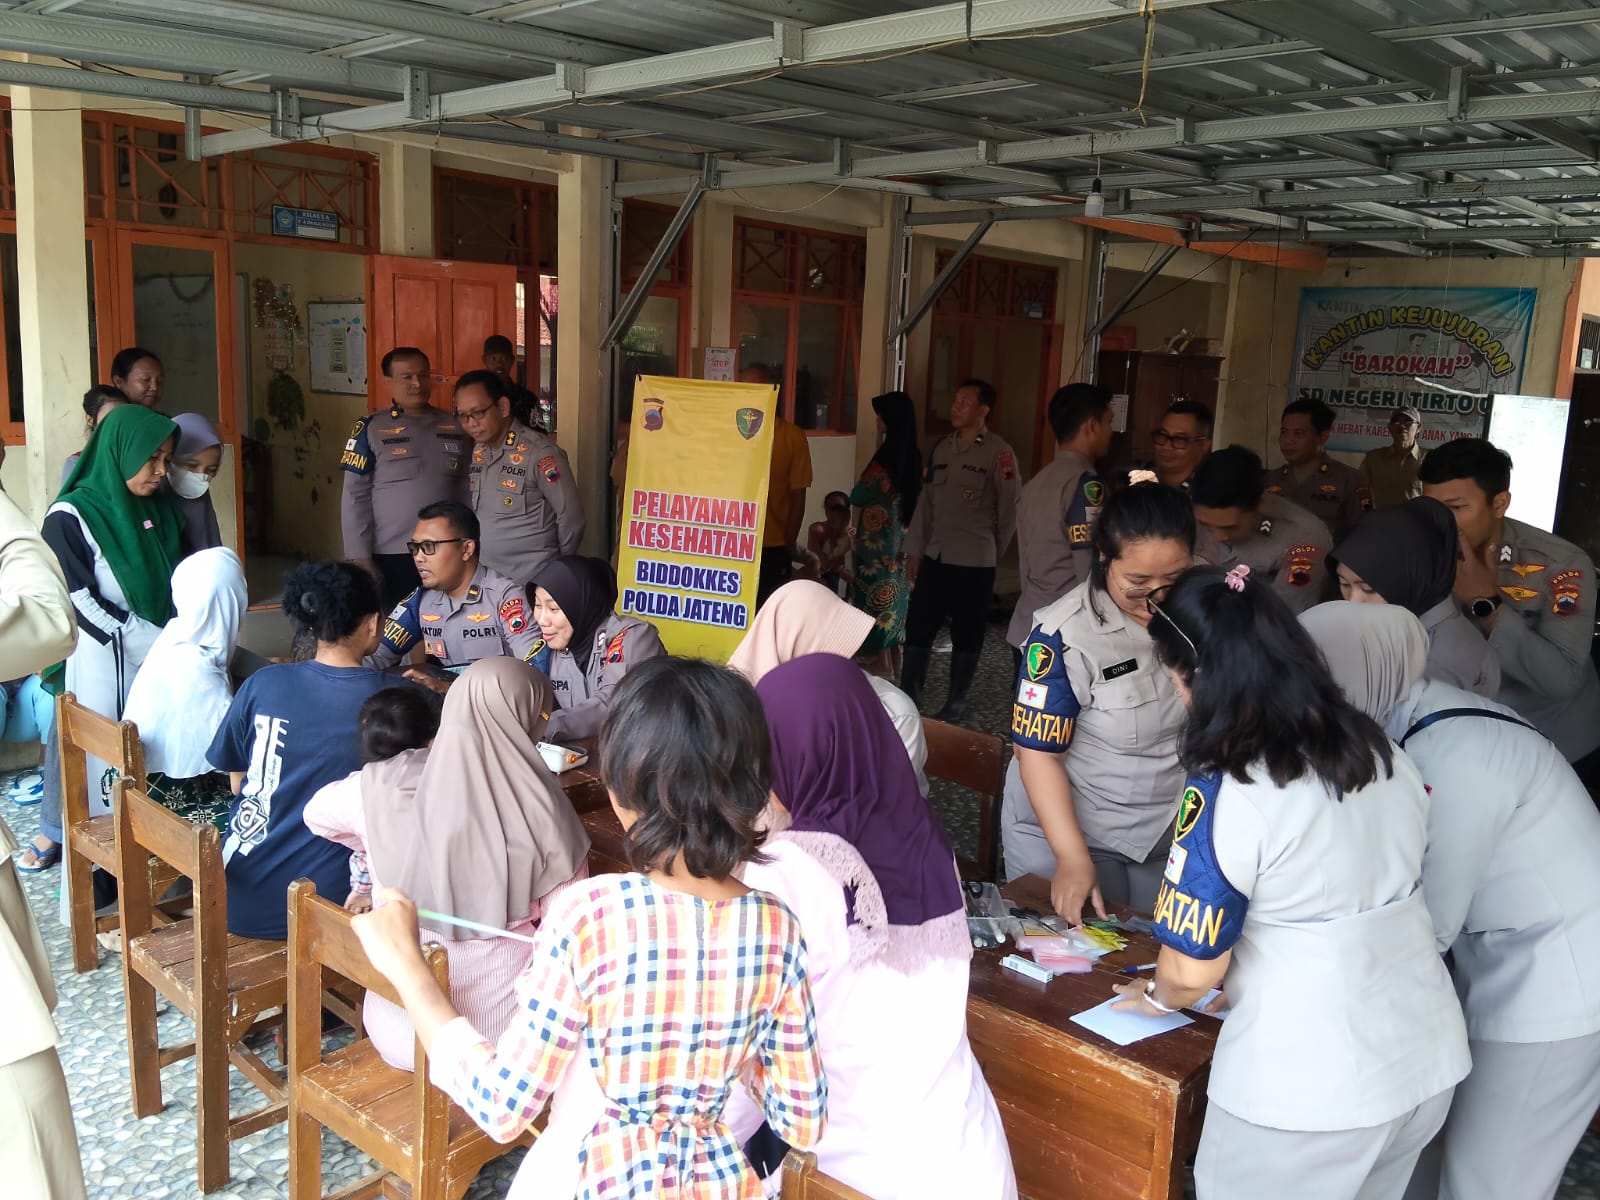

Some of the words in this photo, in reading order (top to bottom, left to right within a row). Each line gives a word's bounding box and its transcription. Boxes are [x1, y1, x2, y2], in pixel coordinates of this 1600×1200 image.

[1304, 308, 1384, 366] KANTIN
[1390, 305, 1514, 376] KEJUJURAN
[1328, 389, 1405, 410] NEGERI
[1409, 391, 1475, 412] TIRTO
[1337, 423, 1364, 436] HEBAT
[1423, 431, 1447, 442] ANAK
[501, 465, 526, 478] POLRI
[631, 489, 758, 529] PELAYANAN
[628, 519, 756, 561] KESEHATAN
[636, 559, 741, 595] BIDDOKKES
[1552, 571, 1580, 584] POLDA
[500, 599, 520, 615] POLDA
[622, 589, 680, 617] POLDA
[682, 597, 747, 627] JATENG
[462, 626, 497, 639] POLRI
[1112, 664, 1128, 675] DINI
